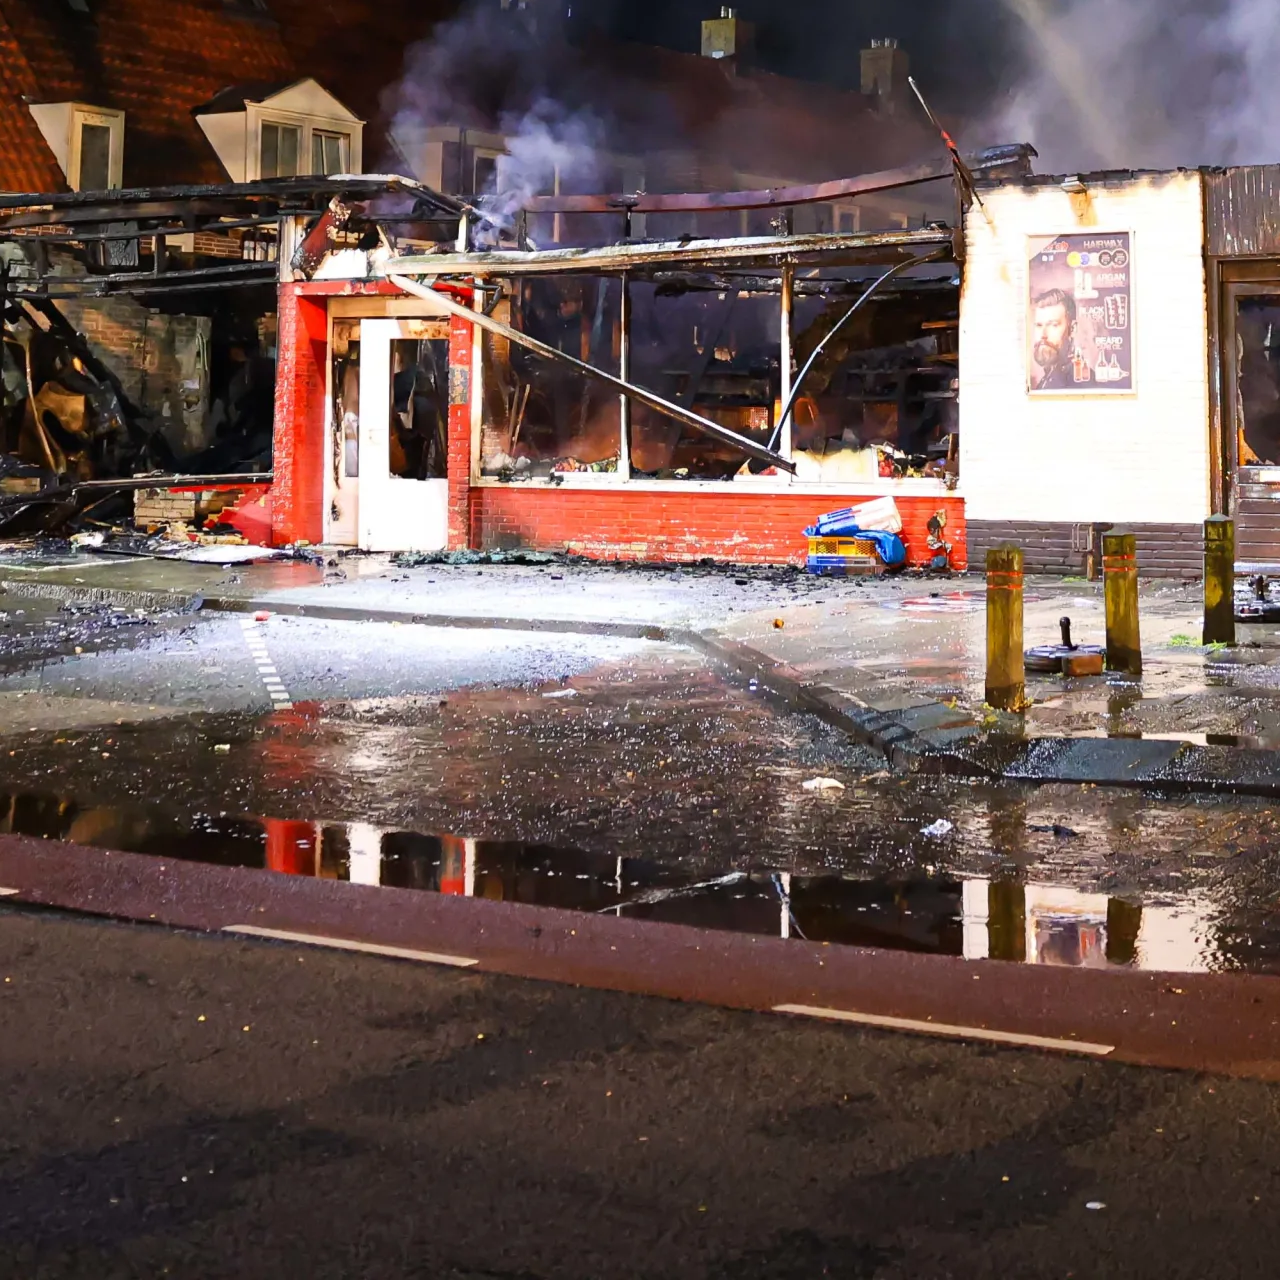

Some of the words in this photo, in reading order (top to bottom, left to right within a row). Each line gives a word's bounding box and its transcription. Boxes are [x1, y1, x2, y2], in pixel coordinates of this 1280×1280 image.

[1083, 239, 1124, 249] HAIRWAX
[1096, 273, 1126, 281] ARGAN
[1095, 336, 1123, 345] BEARD
